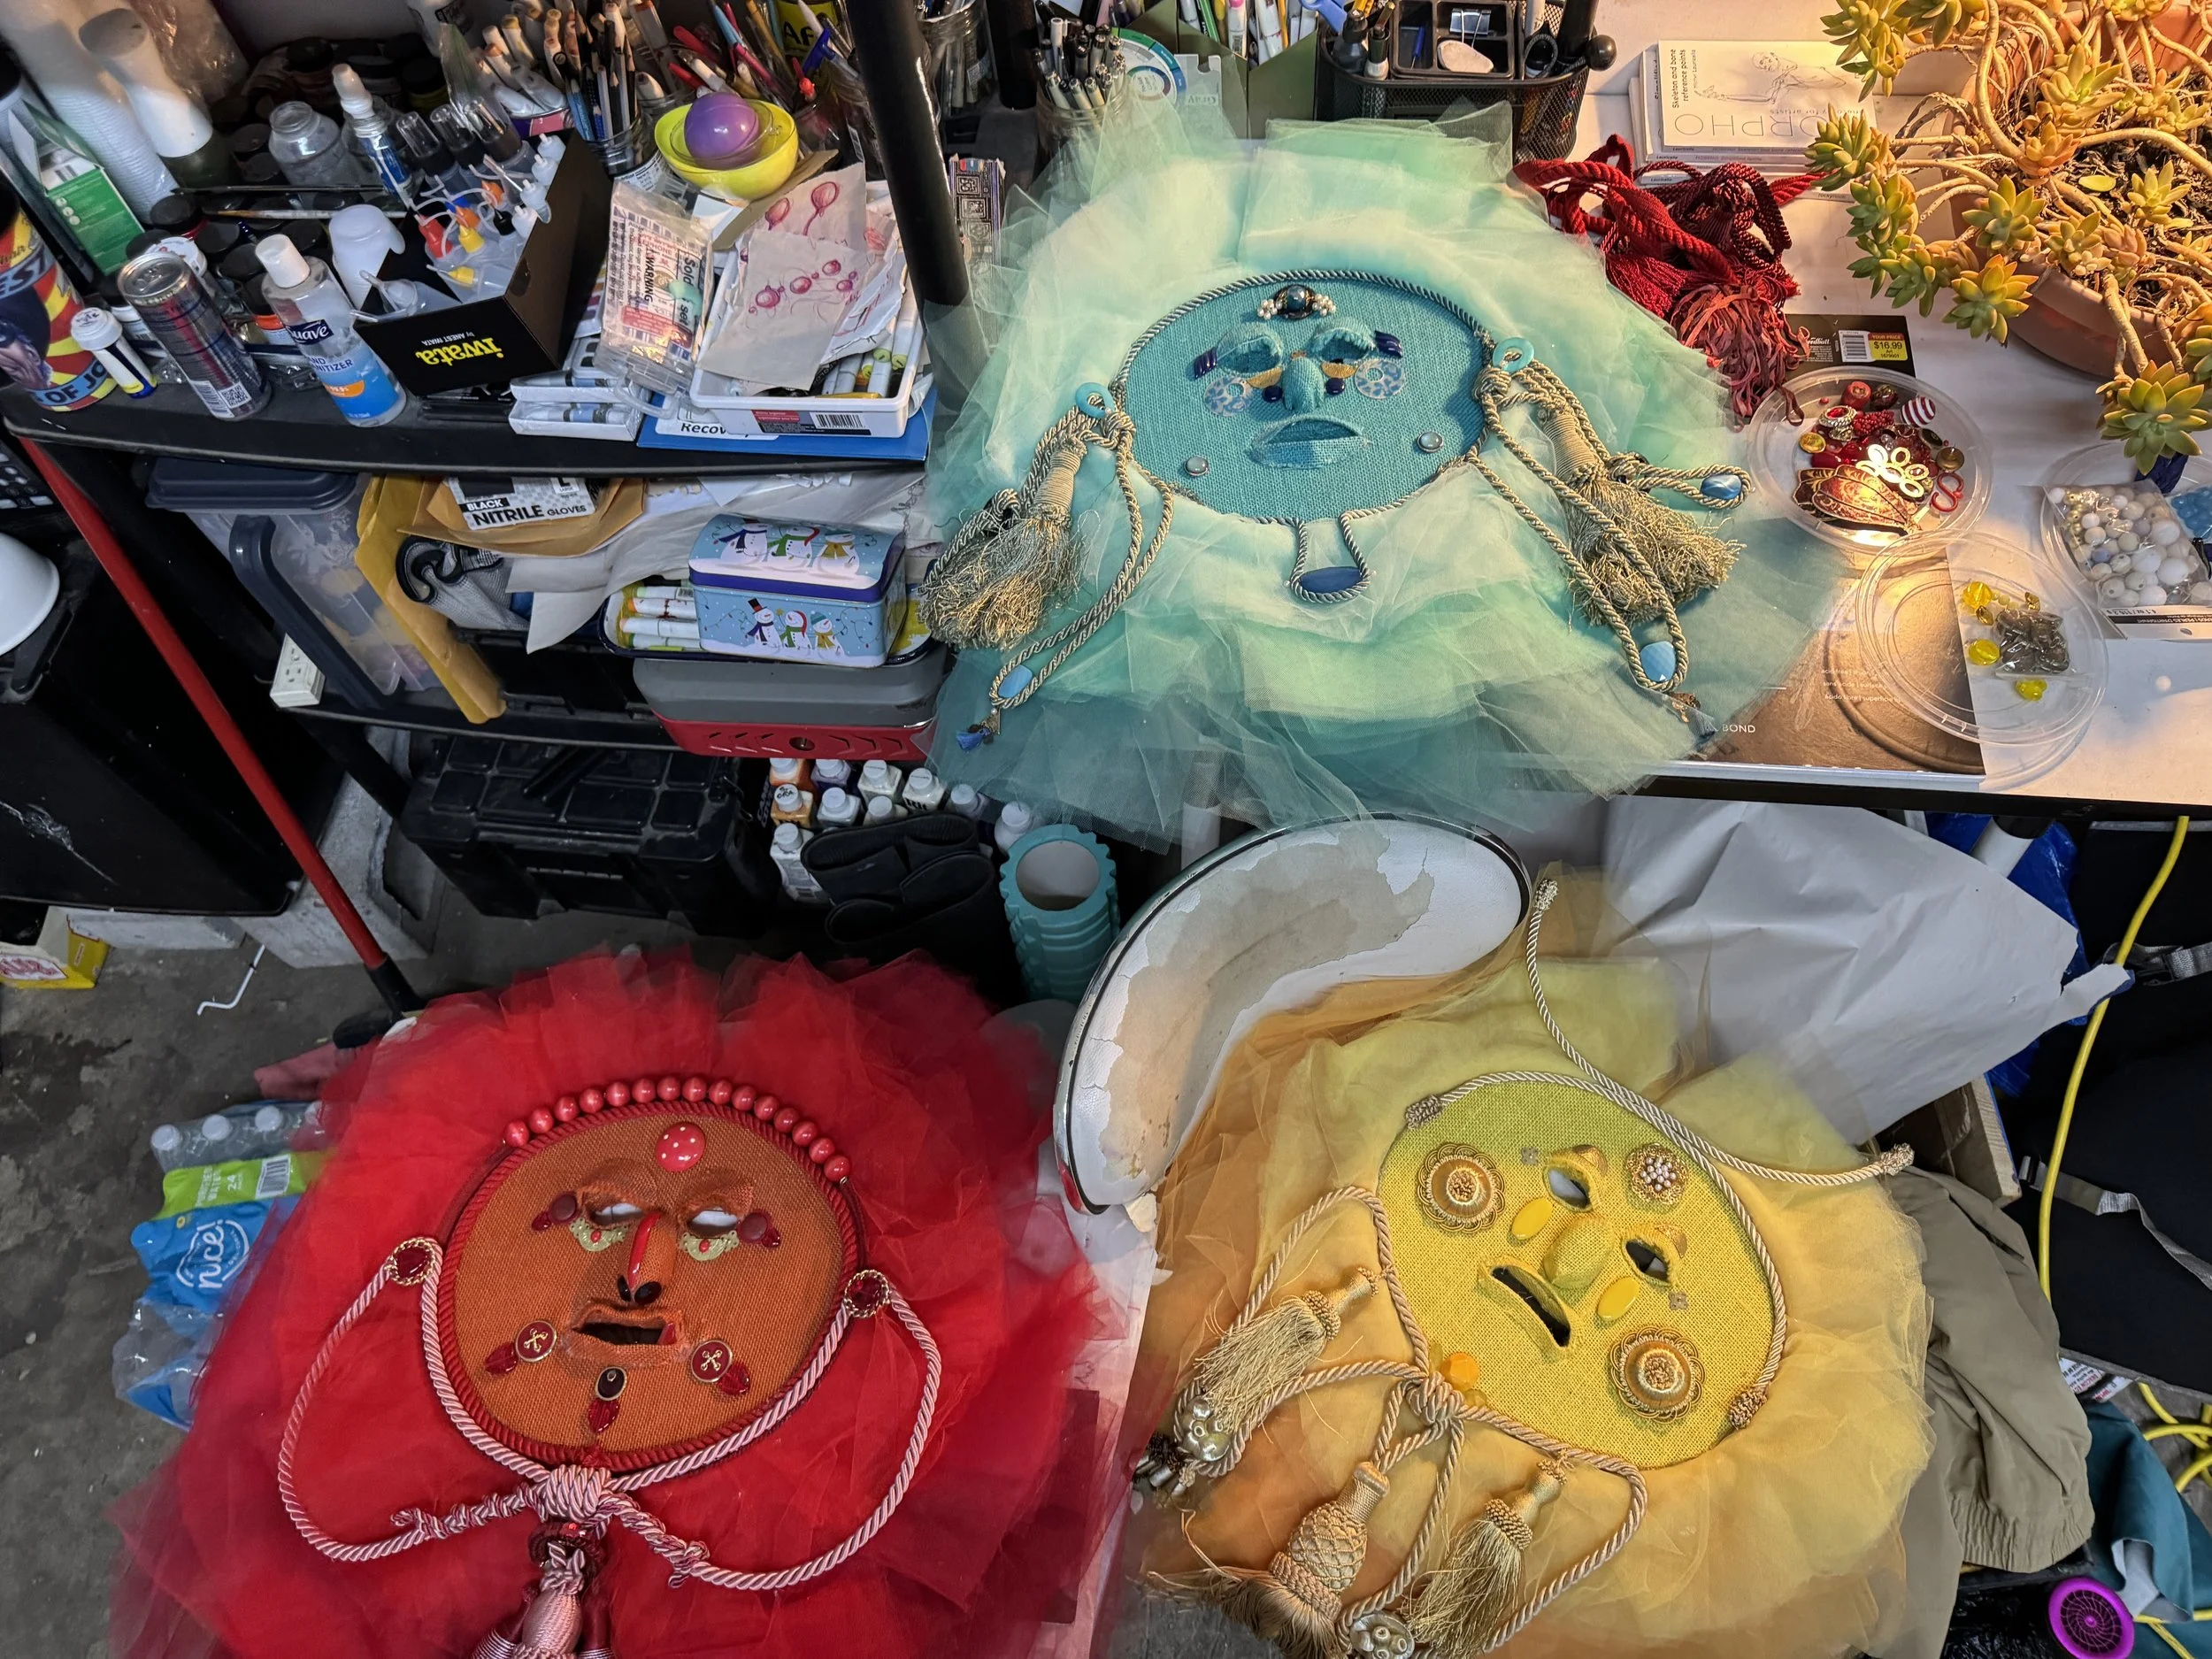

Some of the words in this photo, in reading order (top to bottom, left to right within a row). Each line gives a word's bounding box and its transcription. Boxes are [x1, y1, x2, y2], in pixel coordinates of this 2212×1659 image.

[1678, 49, 1688, 69] points
[1680, 70, 1689, 102] reference
[1674, 113, 1829, 137] ORPHO
[643, 257, 657, 303] WARNING
[683, 257, 696, 288] Sold
[680, 304, 689, 326] set
[415, 337, 504, 366] iwata
[421, 338, 444, 347] IWATA
[1873, 341, 1903, 350] $16.99
[314, 358, 354, 373] NITIZER
[44, 383, 80, 404] OF
[465, 498, 504, 512] BLACK
[472, 504, 545, 526] NITRILE
[547, 504, 588, 517] GLOVES
[1722, 724, 1756, 733] BOND
